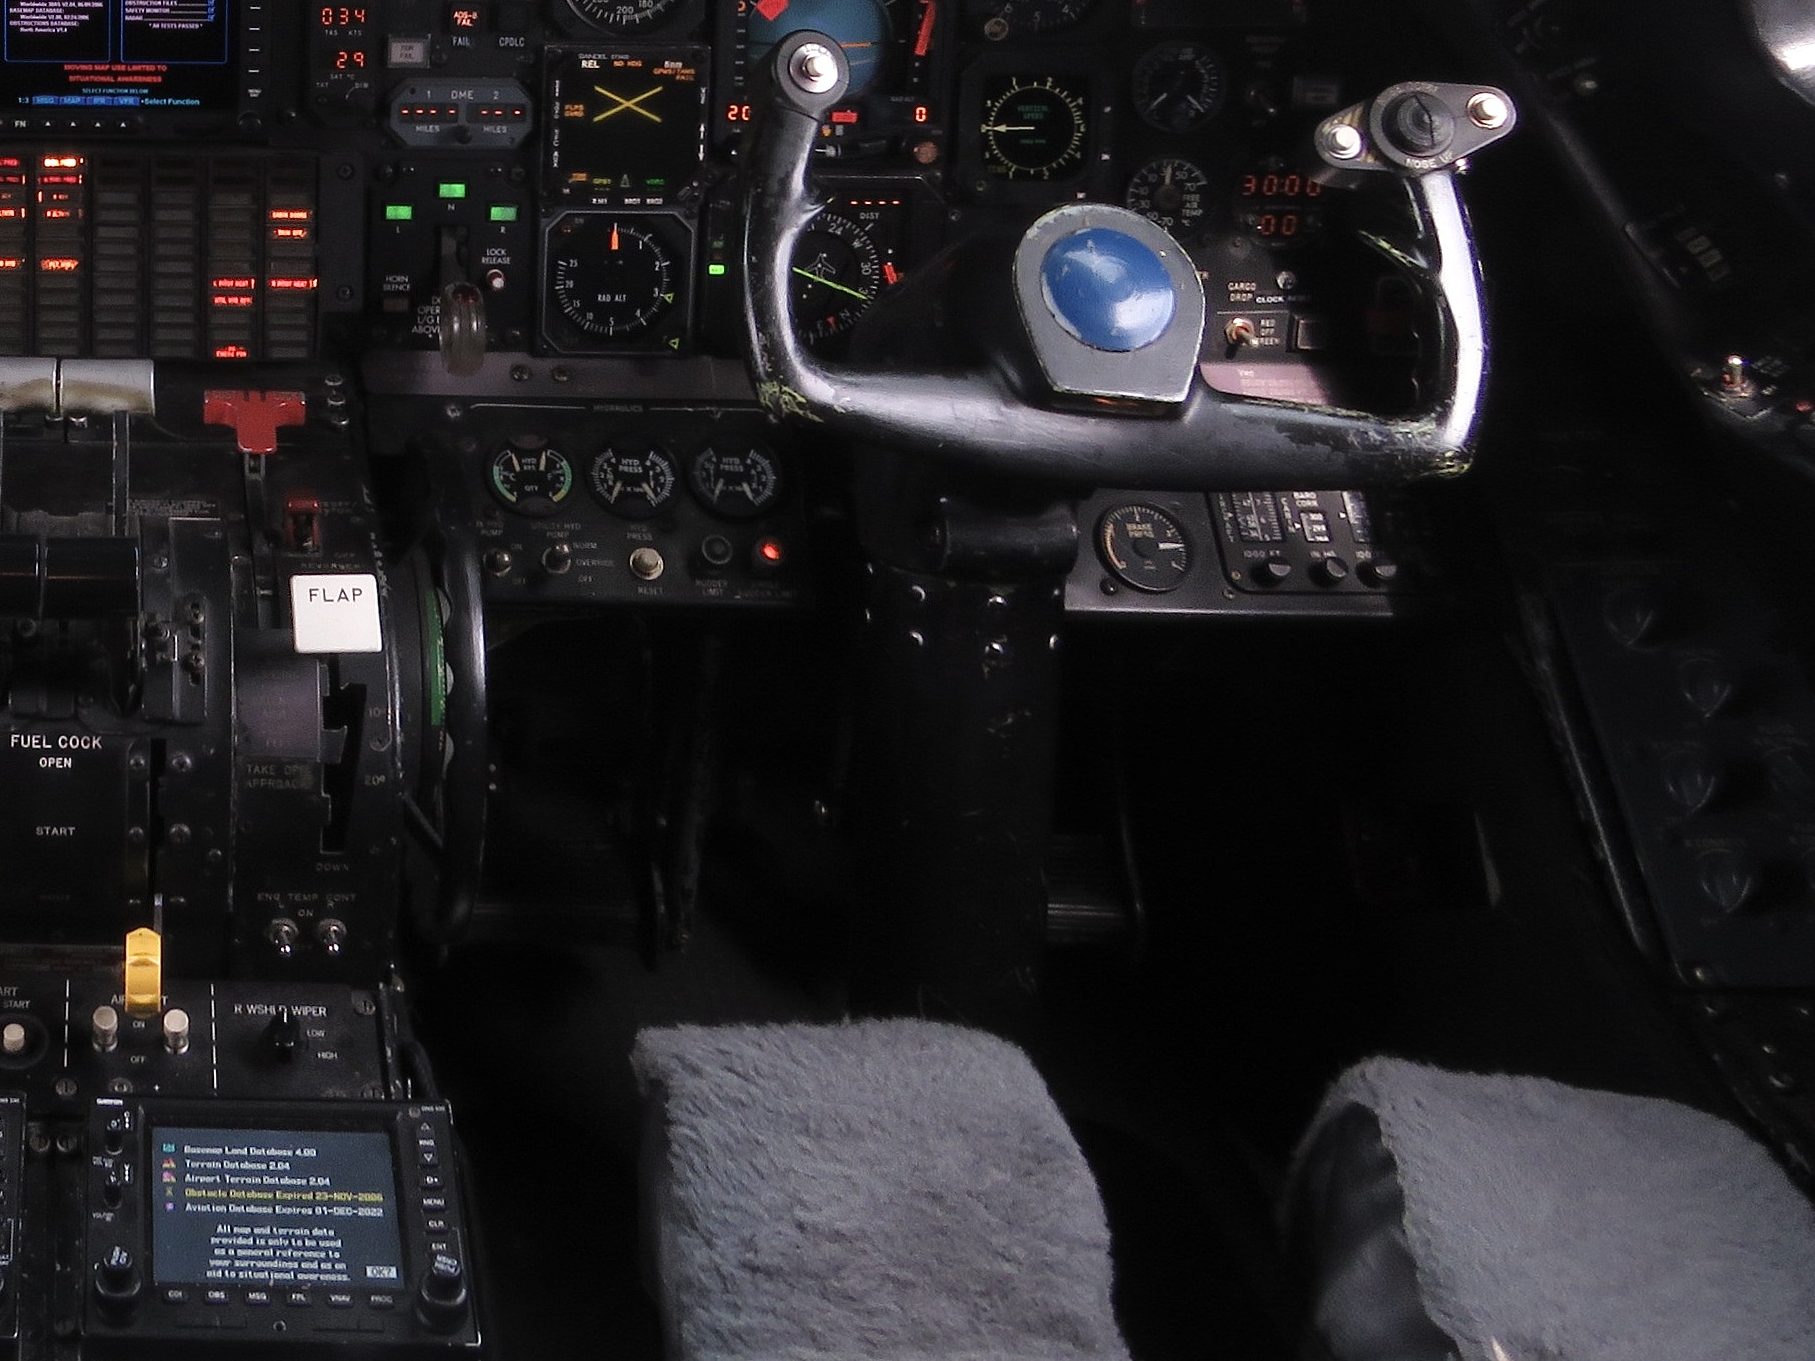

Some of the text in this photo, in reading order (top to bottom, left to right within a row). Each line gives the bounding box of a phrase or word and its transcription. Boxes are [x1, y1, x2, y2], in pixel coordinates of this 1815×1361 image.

[321, 8, 366, 25] 034
[499, 37, 525, 47] CPDLC
[336, 51, 364, 69] 29
[451, 91, 474, 99] DME
[15, 120, 26, 128] FN
[486, 248, 507, 256] LOCK
[482, 256, 511, 264] RELEASE
[385, 275, 408, 283] HORN
[597, 294, 612, 302] RAD
[309, 588, 363, 602] FLAP
[10, 735, 103, 750] FUEL COCK
[39, 757, 72, 769] OPEN
[36, 827, 75, 836] START
[3, 1000, 31, 1008] START
[235, 1004, 242, 1014] R
[291, 1005, 327, 1017] WIPER
[184, 1145, 222, 1155] Basemap
[225, 1146, 247, 1155] Land
[250, 1147, 293, 1156] Database
[185, 1159, 221, 1169] Terrain
[224, 1161, 267, 1170] Database
[185, 1174, 220, 1183] Airport
[225, 1175, 261, 1184] Terrain
[263, 1176, 306, 1185] Database
[185, 1189, 227, 1198] Obstacle
[230, 1190, 273, 1199] Database
[276, 1191, 313, 1201] Expired
[185, 1203, 226, 1213] Aviation
[229, 1204, 272, 1213] Database
[276, 1205, 312, 1215] Expires
